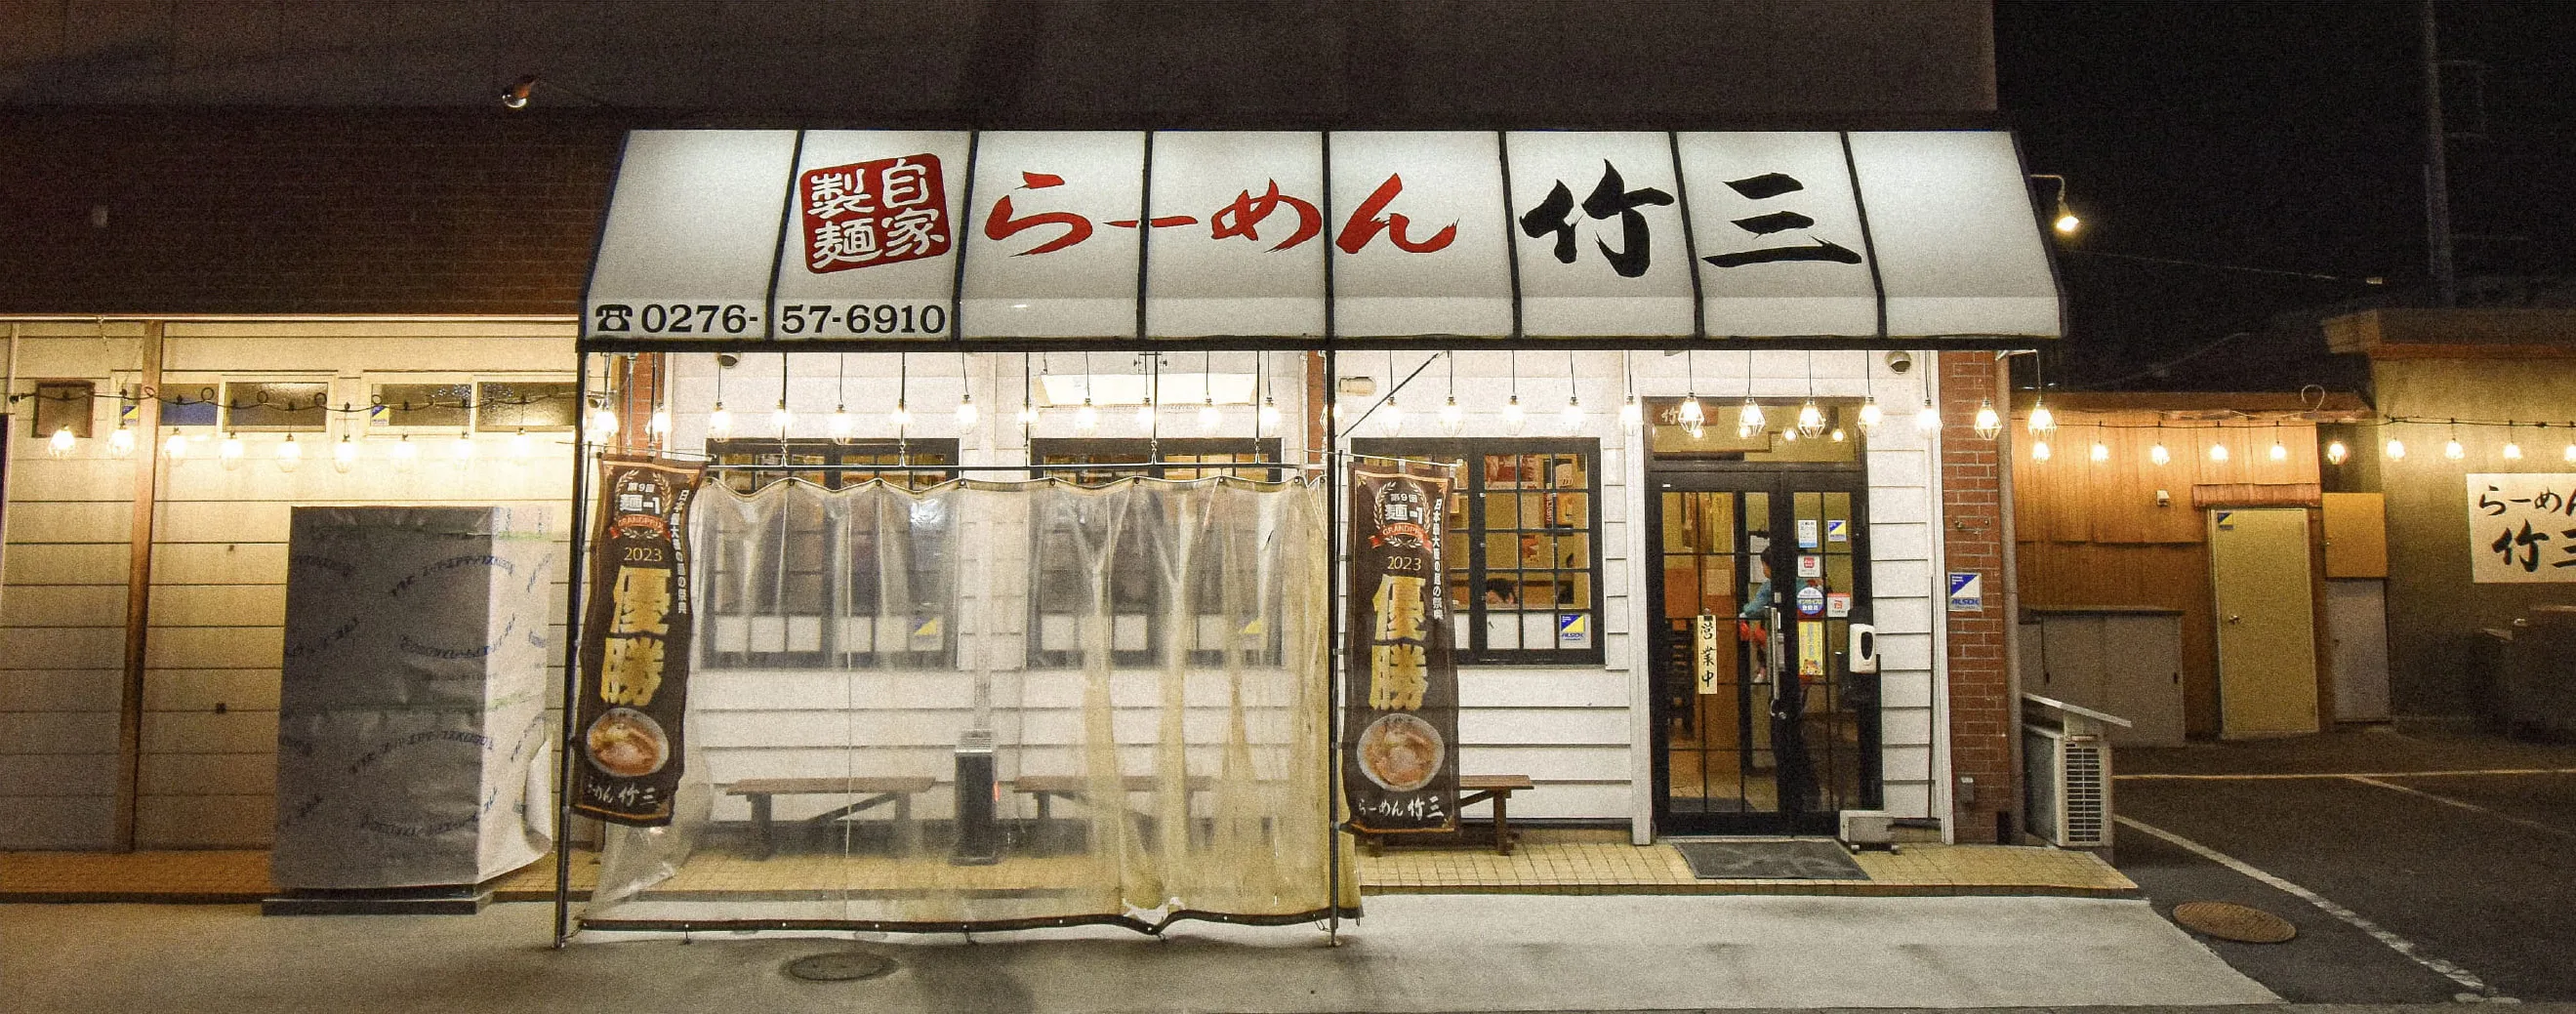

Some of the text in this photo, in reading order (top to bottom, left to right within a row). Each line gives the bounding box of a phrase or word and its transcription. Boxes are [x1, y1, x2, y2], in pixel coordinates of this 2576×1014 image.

[807, 168, 883, 269] 製麺
[881, 158, 945, 258] 自家
[985, 158, 1862, 278] らーめん 竹三
[1390, 493, 1418, 504] 第9回
[624, 547, 663, 562] 2023
[1387, 555, 1421, 571] 2023
[600, 565, 672, 707] 優勝
[1370, 574, 1428, 710] 優勝
[1700, 622, 1716, 688] 営業中
[1359, 794, 1445, 821] らーめん 竹三
